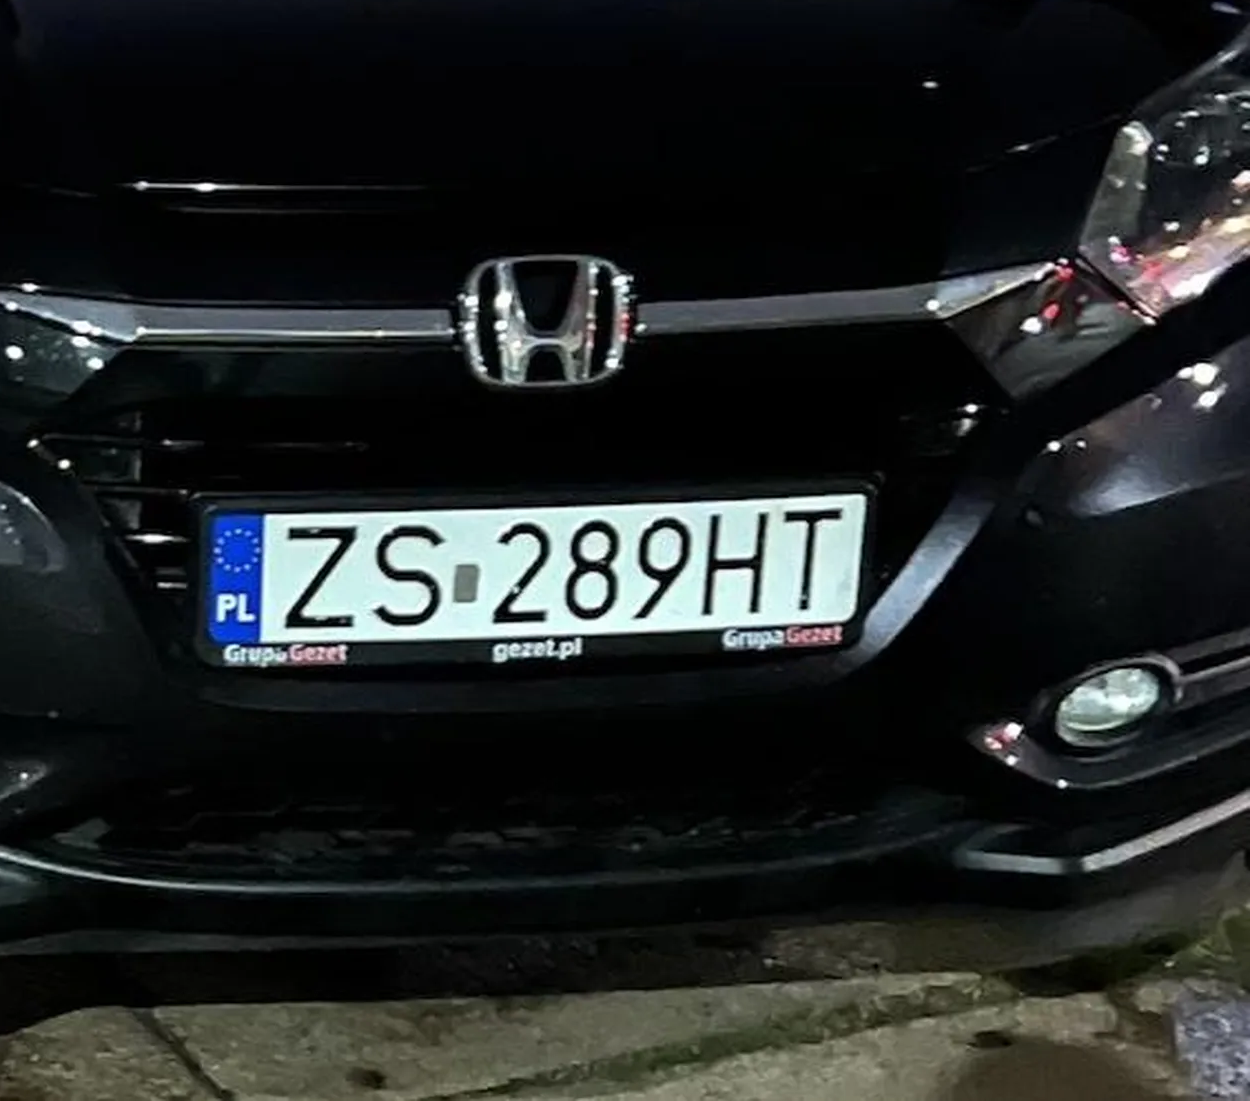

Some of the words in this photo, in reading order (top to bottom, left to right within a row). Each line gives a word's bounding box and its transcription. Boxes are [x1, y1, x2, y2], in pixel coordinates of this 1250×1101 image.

[284, 525, 446, 629] ZS
[491, 509, 844, 624] 289HT
[216, 593, 256, 623] PL
[492, 637, 583, 663] gezet.pl
